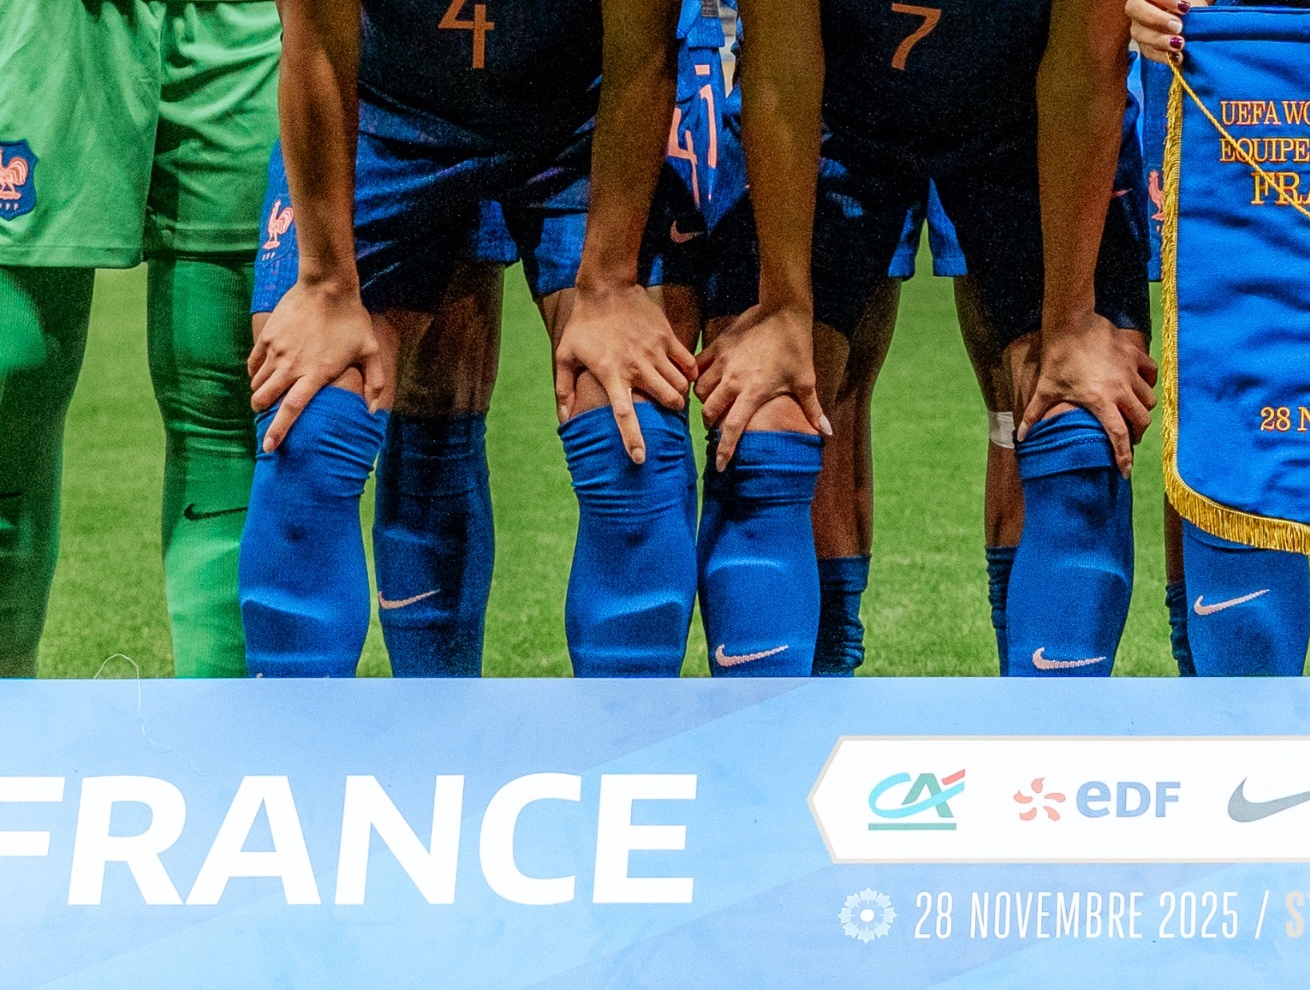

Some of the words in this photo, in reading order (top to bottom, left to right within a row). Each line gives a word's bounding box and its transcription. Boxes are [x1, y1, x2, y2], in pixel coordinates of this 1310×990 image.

[891, 3, 942, 70] 7
[1220, 100, 1281, 126] UEFA
[1219, 138, 1310, 163] EQUIPE
[1260, 406, 1291, 432] 28
[0, 772, 698, 905] FRANCE
[914, 891, 954, 940] 28
[970, 892, 1144, 940] NOVEMBRE
[1159, 891, 1239, 940] 2025
